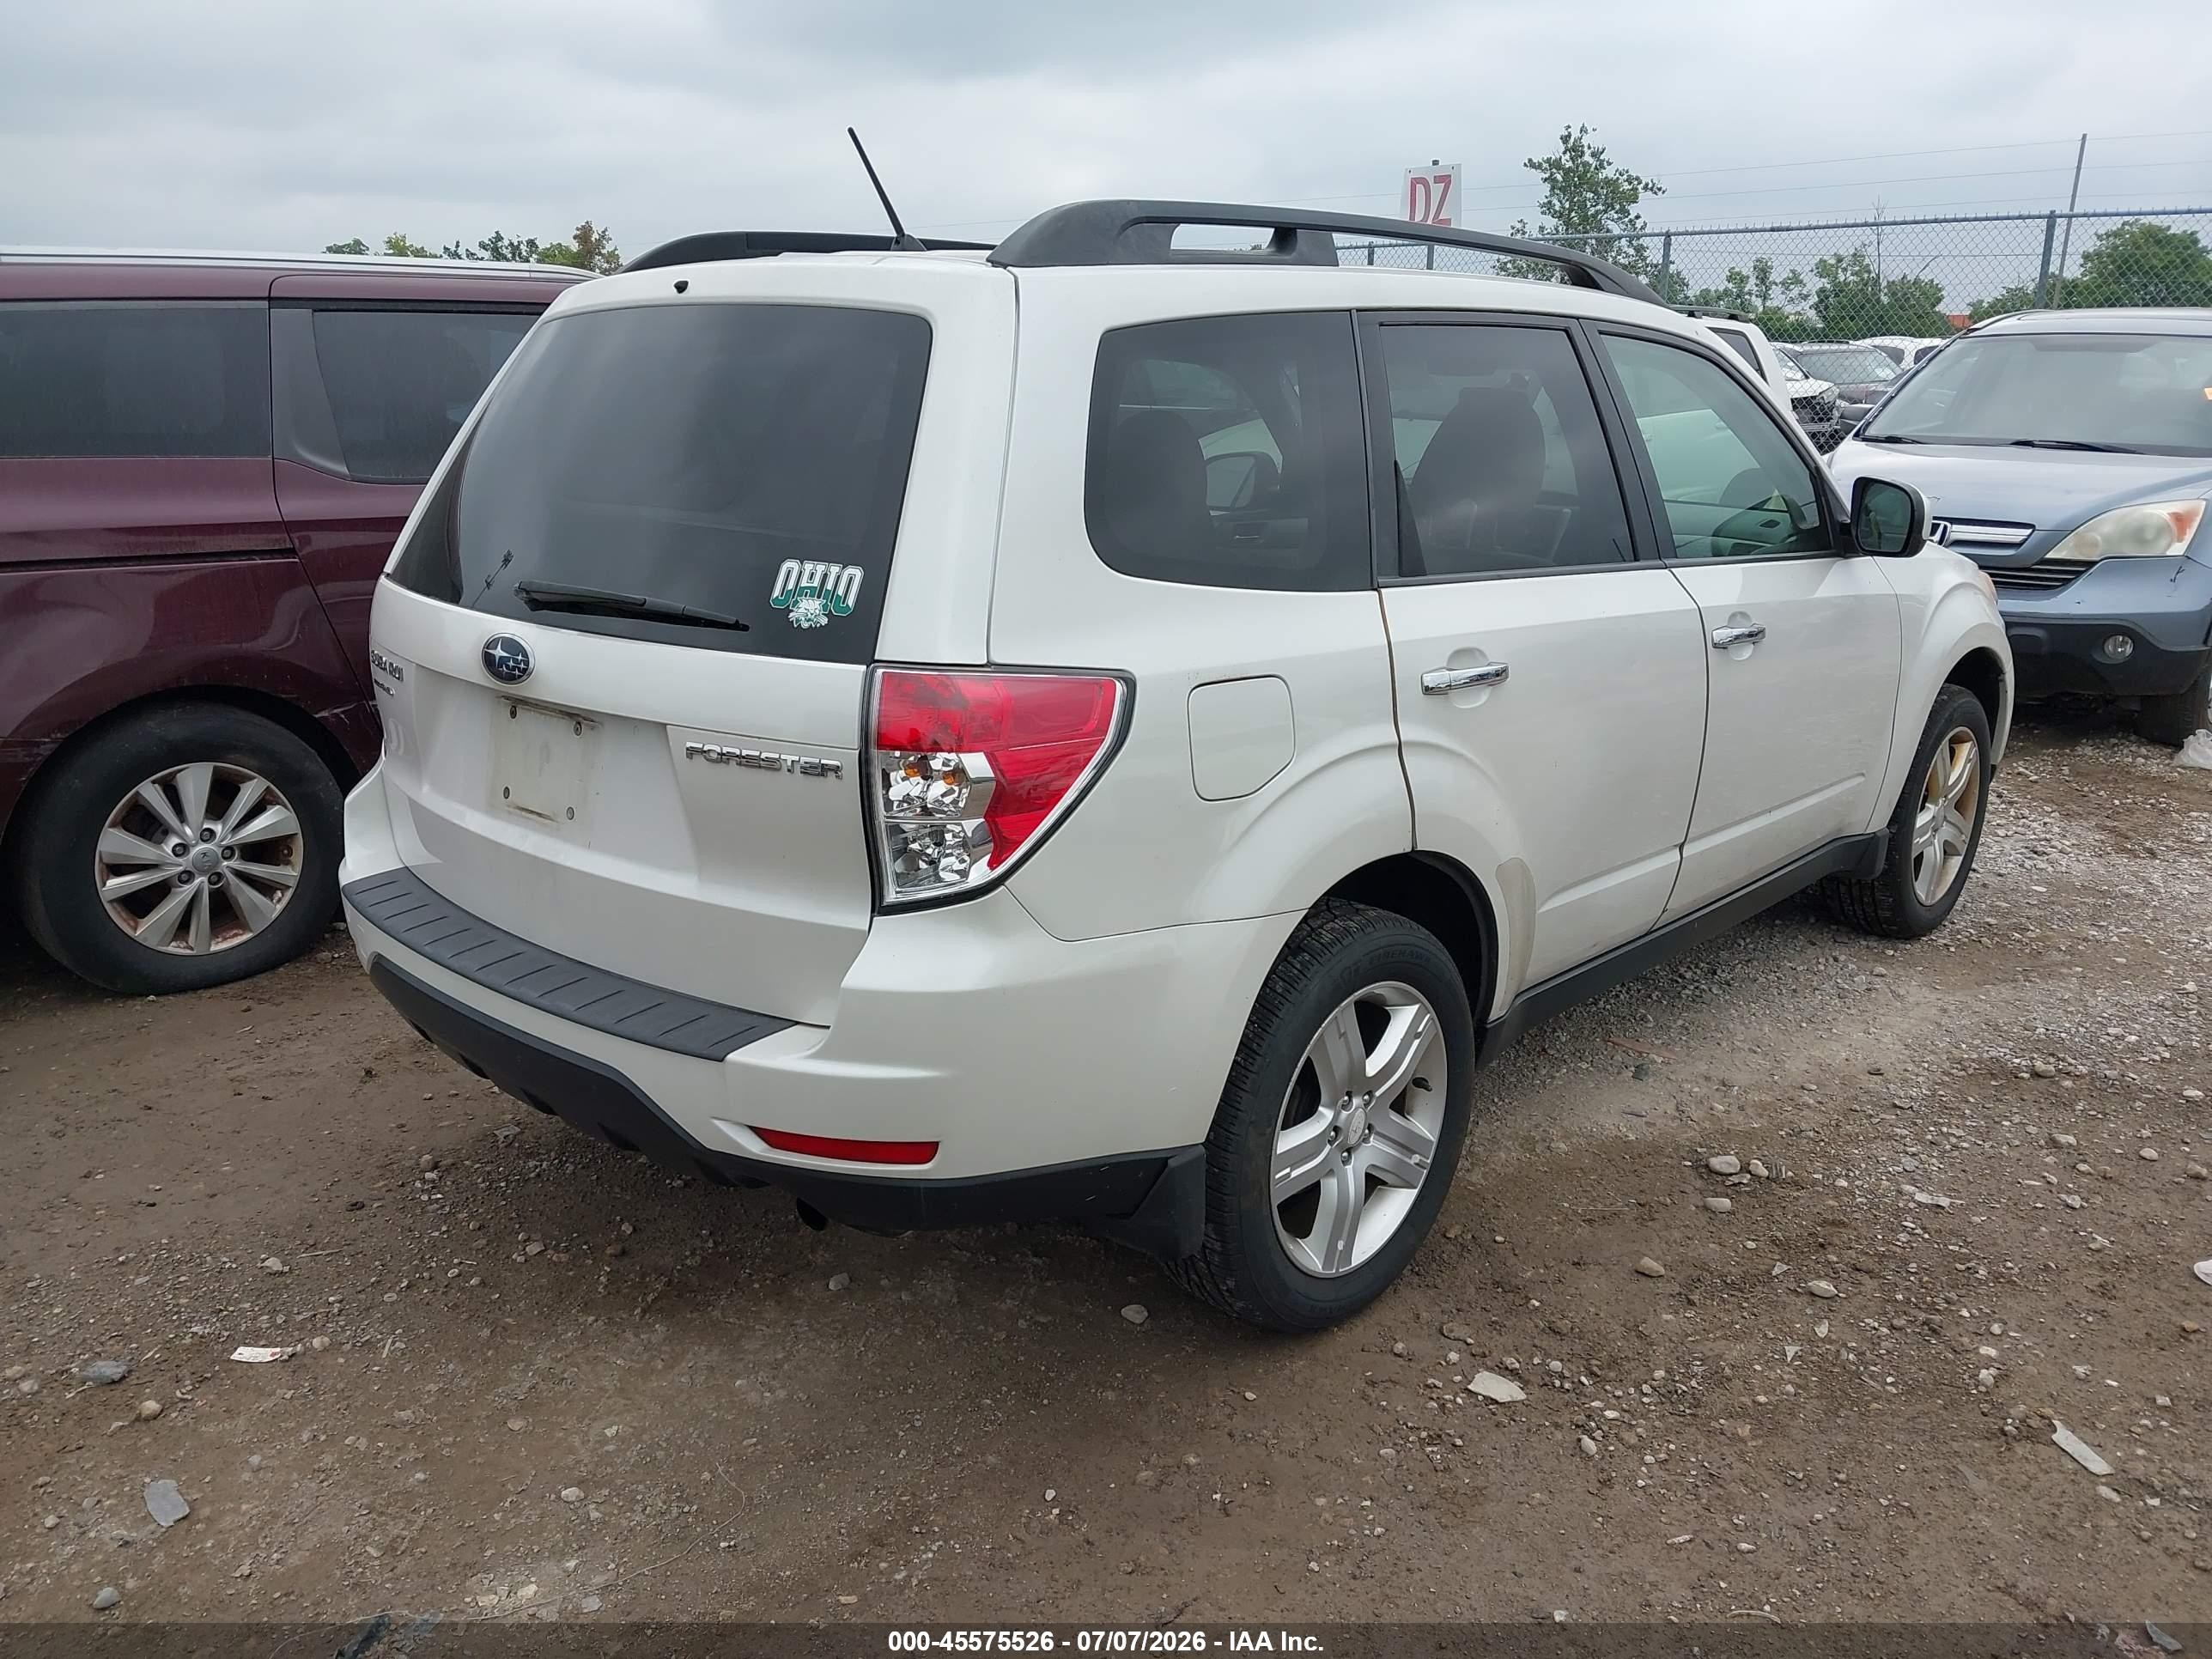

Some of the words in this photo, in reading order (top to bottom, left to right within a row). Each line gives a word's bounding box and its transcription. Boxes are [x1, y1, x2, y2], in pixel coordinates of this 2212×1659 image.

[1408, 173, 1452, 227] DZ
[770, 558, 865, 617] OHIO
[685, 741, 843, 780] FORESTER
